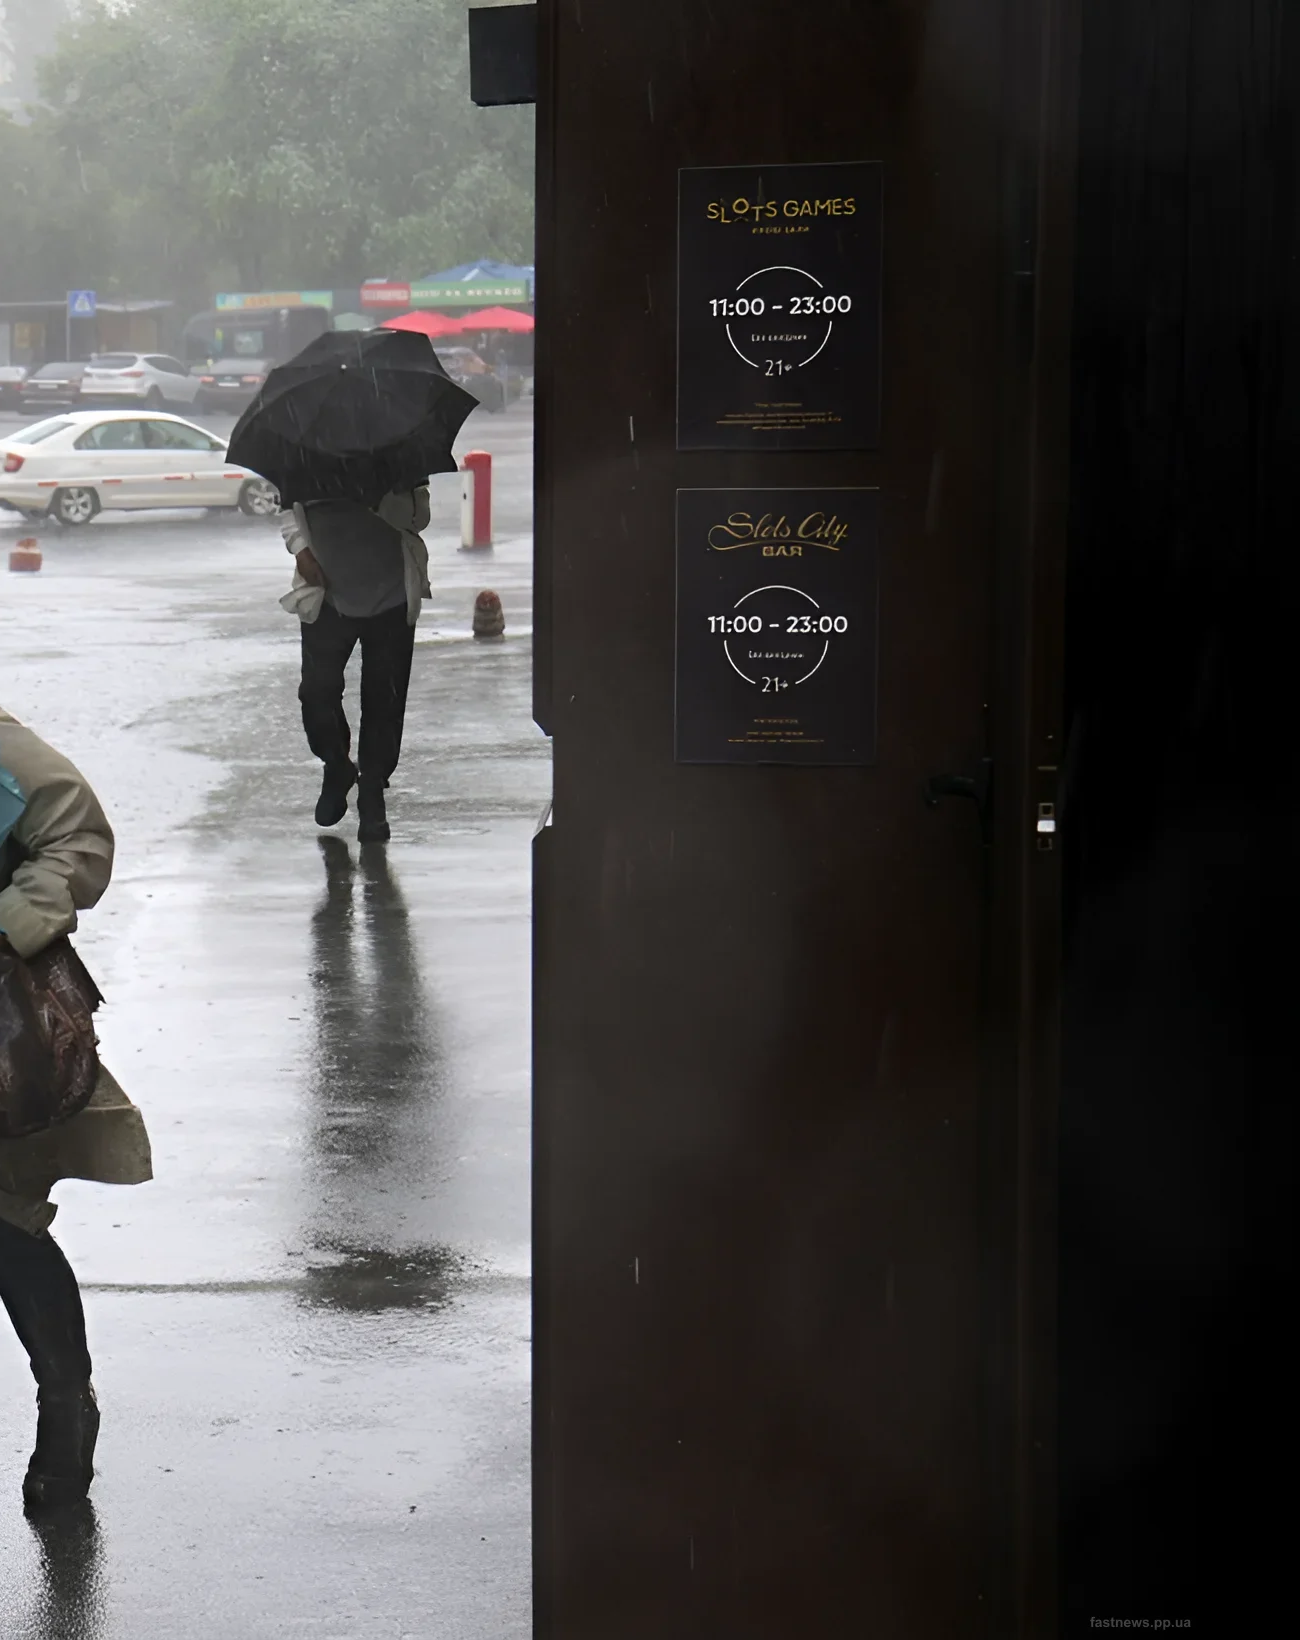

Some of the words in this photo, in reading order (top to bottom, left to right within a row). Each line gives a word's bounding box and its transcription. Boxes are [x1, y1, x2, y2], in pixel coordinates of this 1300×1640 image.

[706, 197, 778, 223] SLOTS
[783, 197, 856, 217] GAMES
[709, 297, 765, 317] 11:00
[789, 295, 852, 315] 23:00
[707, 615, 763, 633] 11:00
[786, 615, 848, 634] 23:00
[761, 676, 789, 693] 21+
